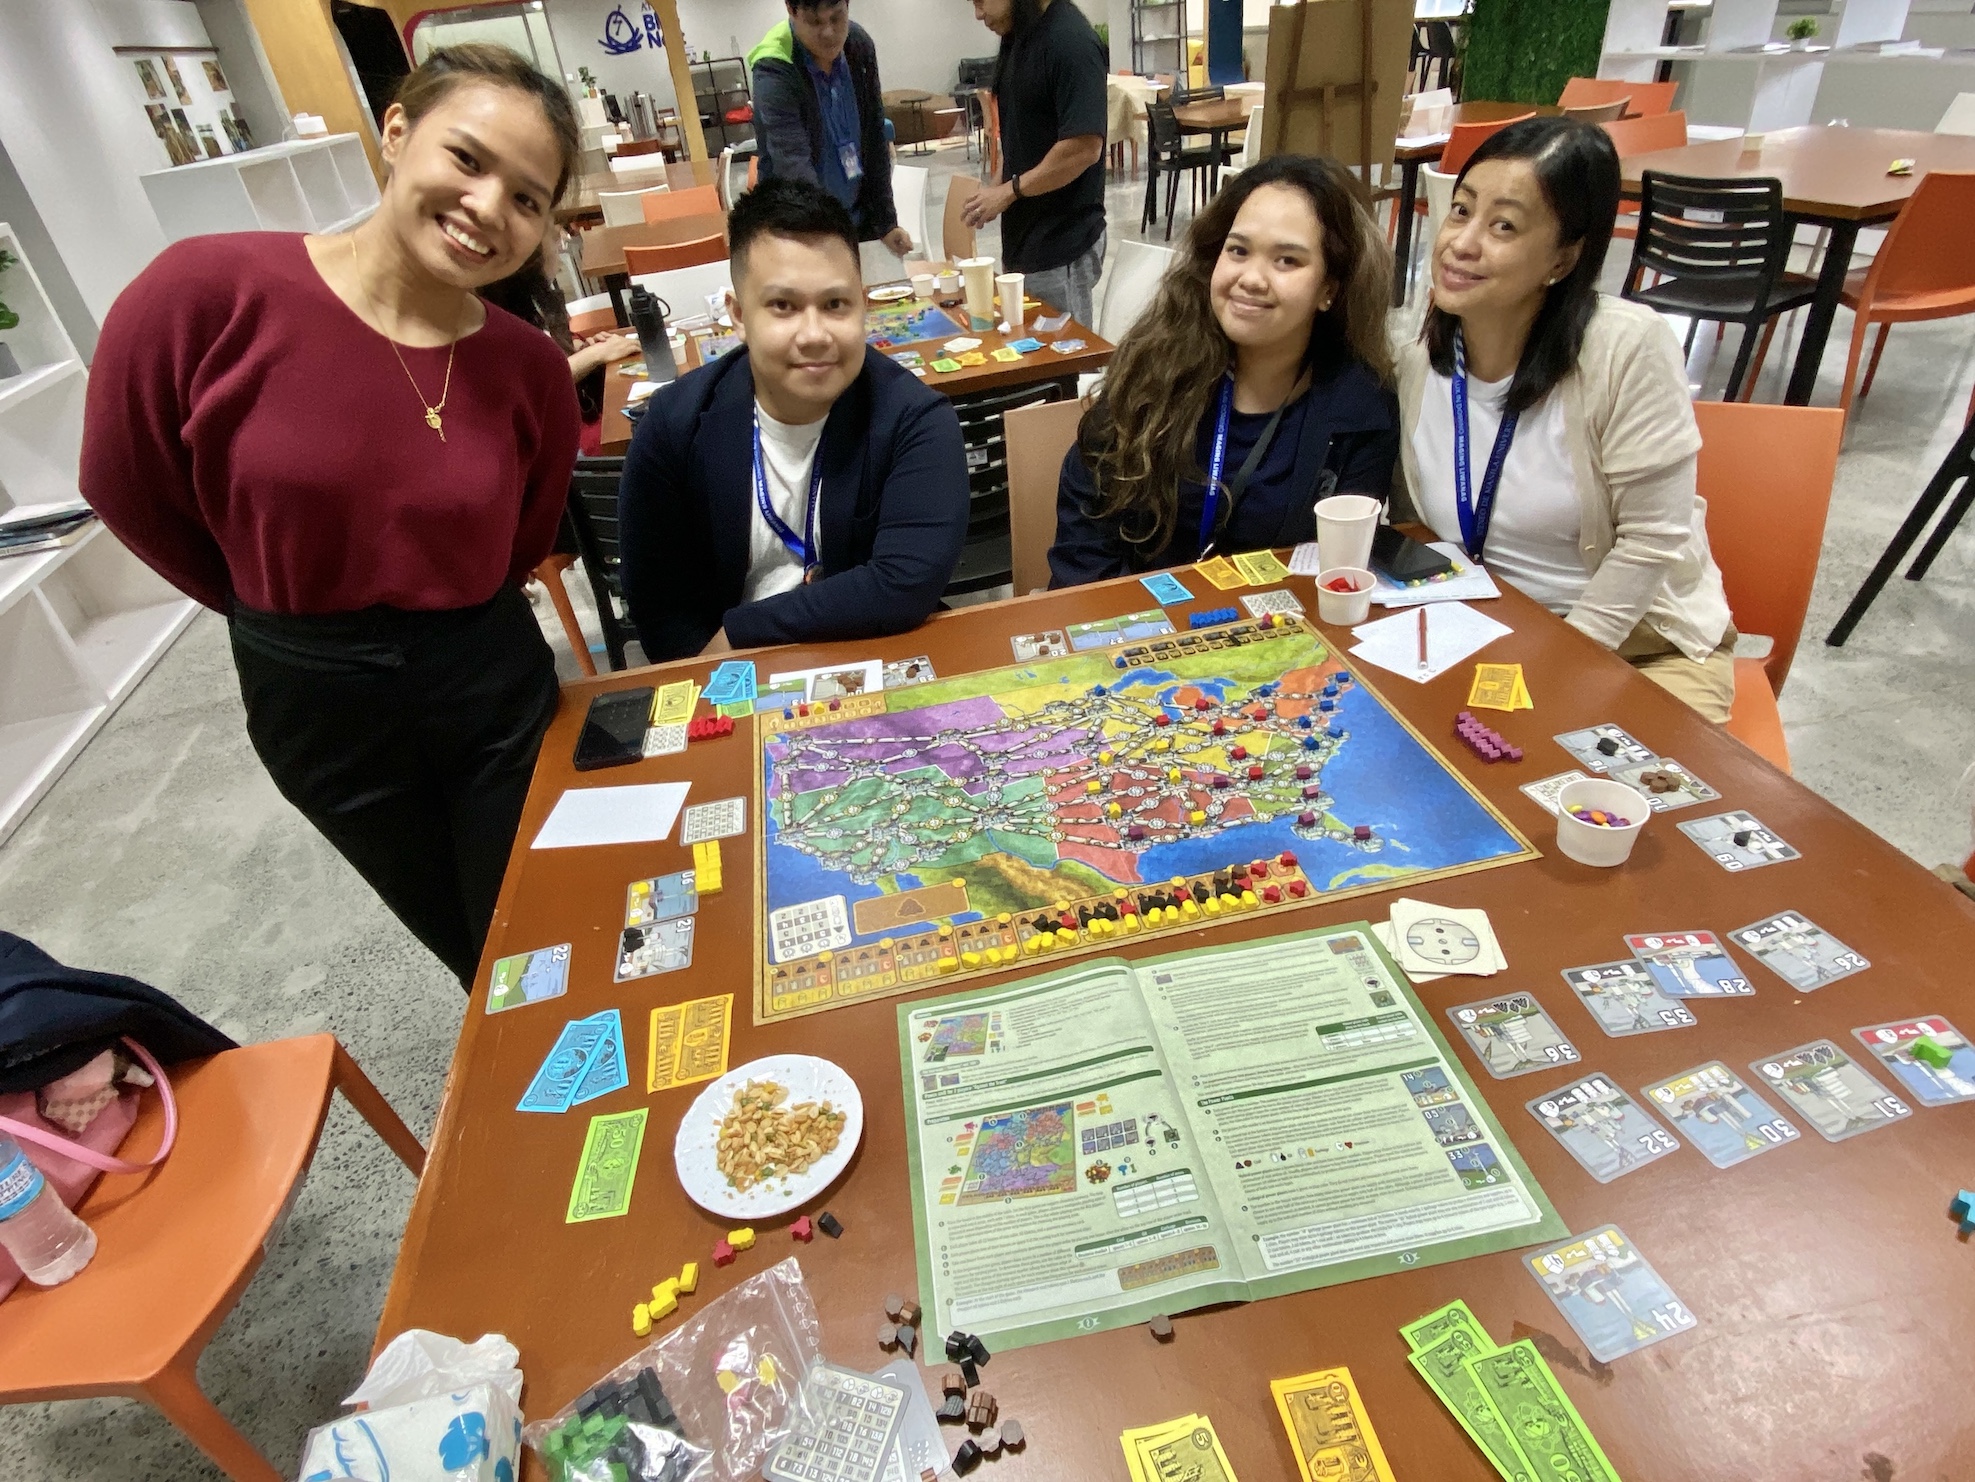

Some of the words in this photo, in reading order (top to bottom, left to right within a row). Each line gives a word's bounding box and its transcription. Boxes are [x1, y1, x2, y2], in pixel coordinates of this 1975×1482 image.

[1459, 467, 1468, 502] LIWANAG
[1587, 759, 1609, 773] 16
[676, 918, 692, 933] 21
[551, 945, 568, 963] 22
[1833, 952, 1866, 972] 26
[1717, 977, 1751, 994] 28
[1659, 1007, 1693, 1027] 35
[1544, 1042, 1577, 1063] 36
[1872, 1096, 1908, 1122] 31
[610, 1128, 626, 1149] 50
[1758, 1118, 1796, 1144] 30
[1638, 1130, 1676, 1156] 32
[1652, 1301, 1692, 1332] 24
[1453, 1330, 1472, 1349] 50
[1515, 1346, 1533, 1366] 50
[1330, 1382, 1346, 1401] 10
[841, 1394, 847, 1402] 7
[867, 1402, 877, 1412] 14
[863, 1413, 872, 1422] 15
[824, 1430, 834, 1439] 10
[854, 1439, 863, 1448] 17
[866, 1442, 879, 1453] 142
[859, 1426, 868, 1436] 16
[870, 1430, 884, 1441] 138
[1195, 1432, 1210, 1444] 5
[802, 1437, 813, 1448] 54
[820, 1443, 828, 1452] 11
[832, 1446, 843, 1457] 112
[815, 1455, 824, 1465] 12
[780, 1460, 787, 1469] 6
[792, 1462, 803, 1472] 73
[809, 1468, 819, 1478] 13
[821, 1472, 834, 1482] 124
